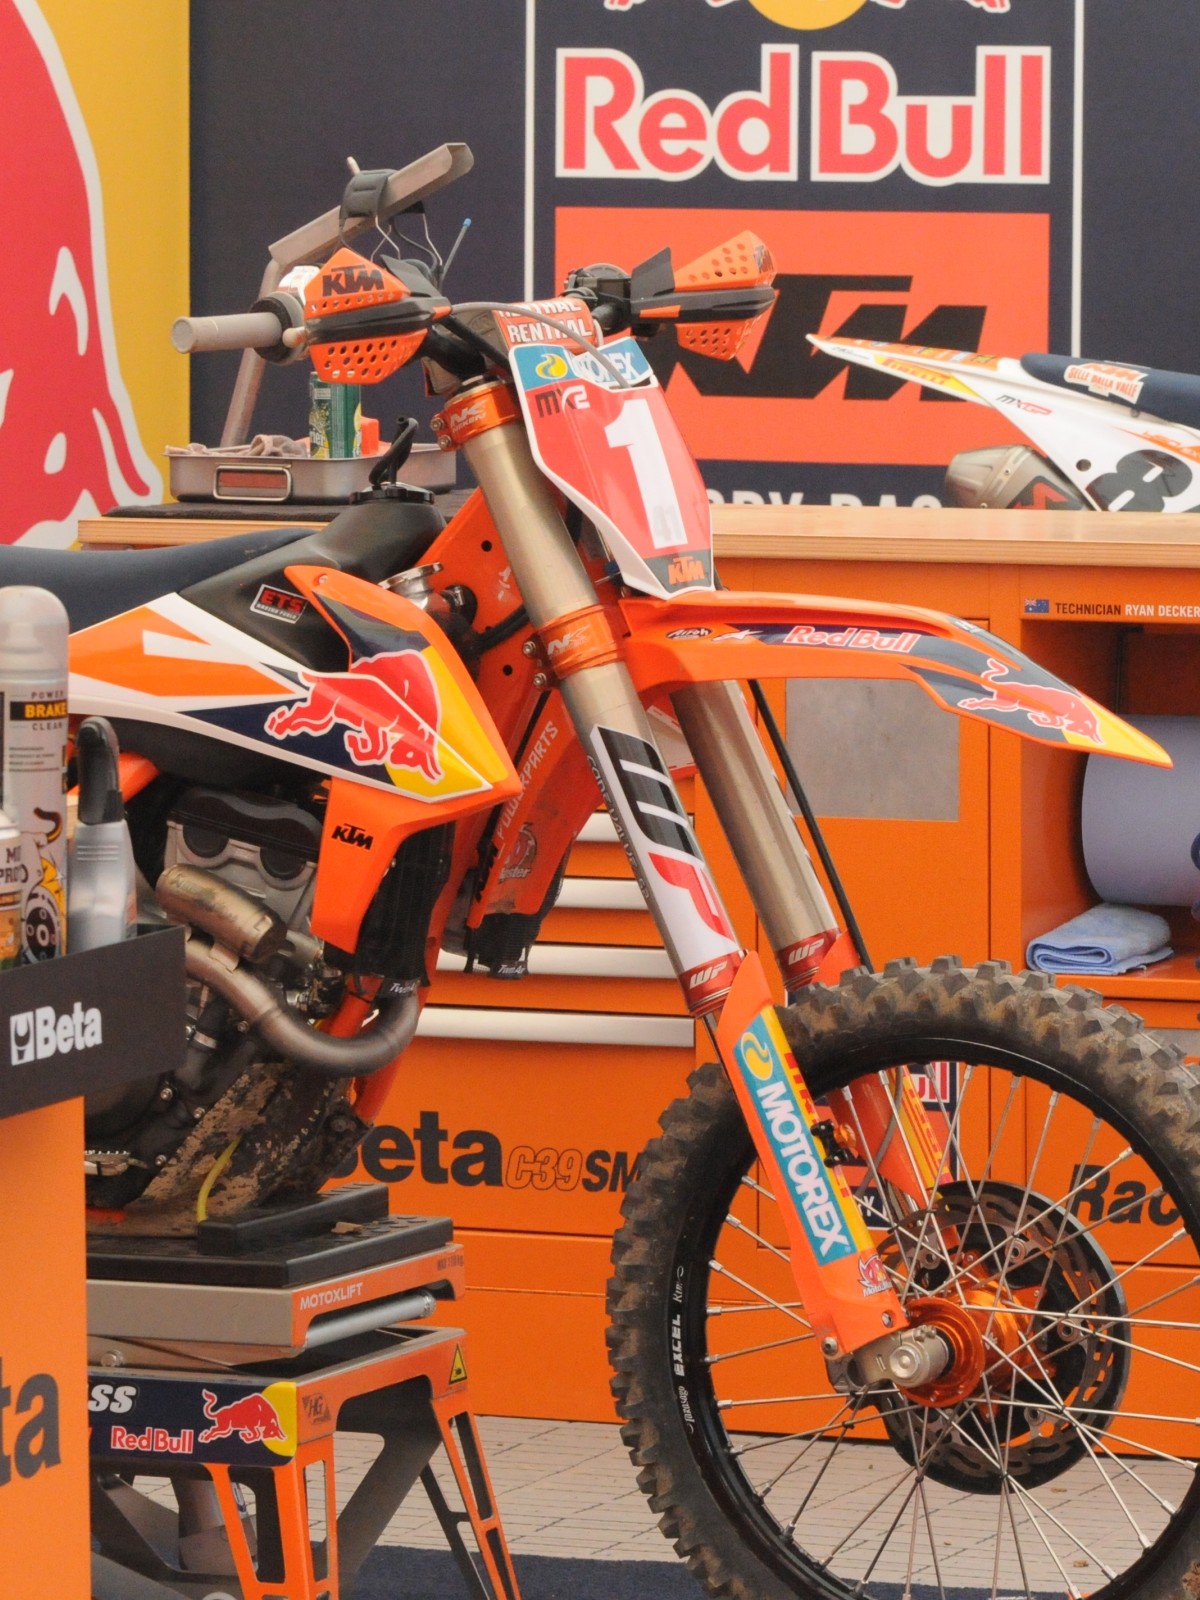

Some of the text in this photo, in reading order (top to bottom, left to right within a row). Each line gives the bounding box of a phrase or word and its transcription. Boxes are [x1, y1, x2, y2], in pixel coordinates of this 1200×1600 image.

[556, 44, 1050, 186] Red Bull
[322, 264, 384, 297] KTM
[604, 398, 688, 549] 1
[668, 556, 705, 585] KTM
[261, 590, 304, 615] ETS
[1055, 602, 1121, 616] TECHNICIAN
[1125, 603, 1154, 617] RYAN
[783, 626, 921, 653] Red Bull
[24, 701, 67, 719] BRAKE
[331, 823, 374, 850] KTM
[788, 938, 825, 966] WP
[689, 961, 728, 990] WP
[35, 1002, 103, 1060] Beta
[330, 1111, 504, 1187] eta
[756, 1081, 851, 1257] MOTOREX
[300, 1282, 364, 1311] MOTOXLIFT
[672, 1314, 685, 1377] EXCEL
[111, 1426, 194, 1454] Red Bull
